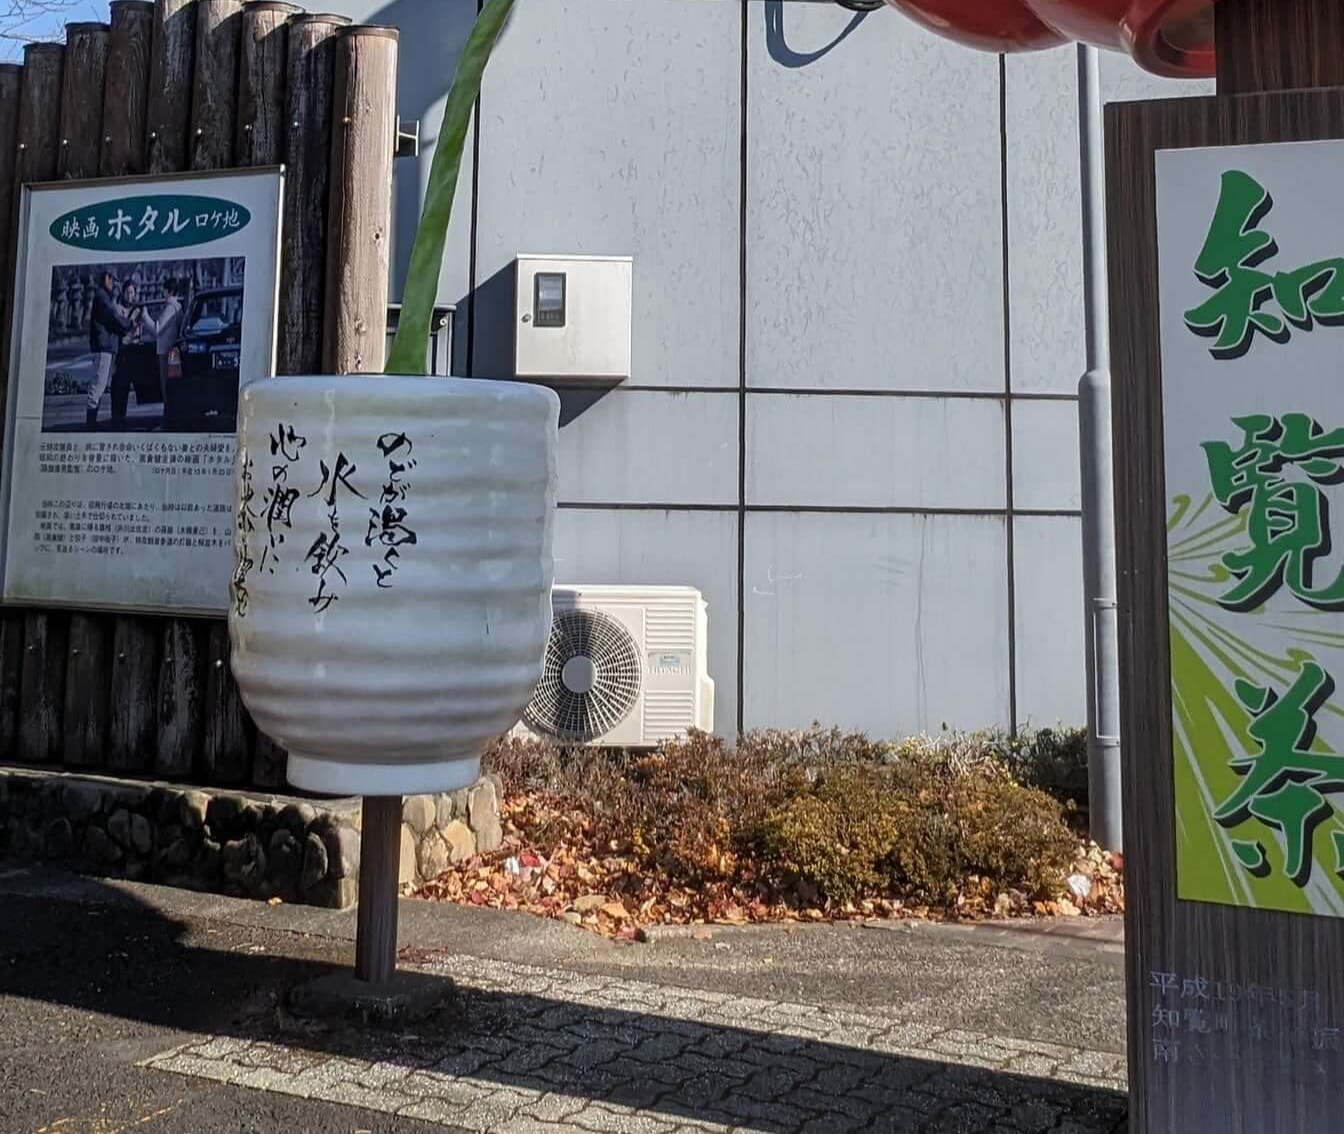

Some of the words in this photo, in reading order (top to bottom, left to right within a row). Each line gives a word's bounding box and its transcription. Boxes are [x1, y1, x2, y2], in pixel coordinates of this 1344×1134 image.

[61, 216, 99, 239] 映画
[108, 205, 191, 241] ホタル
[195, 207, 241, 229] ロケ地
